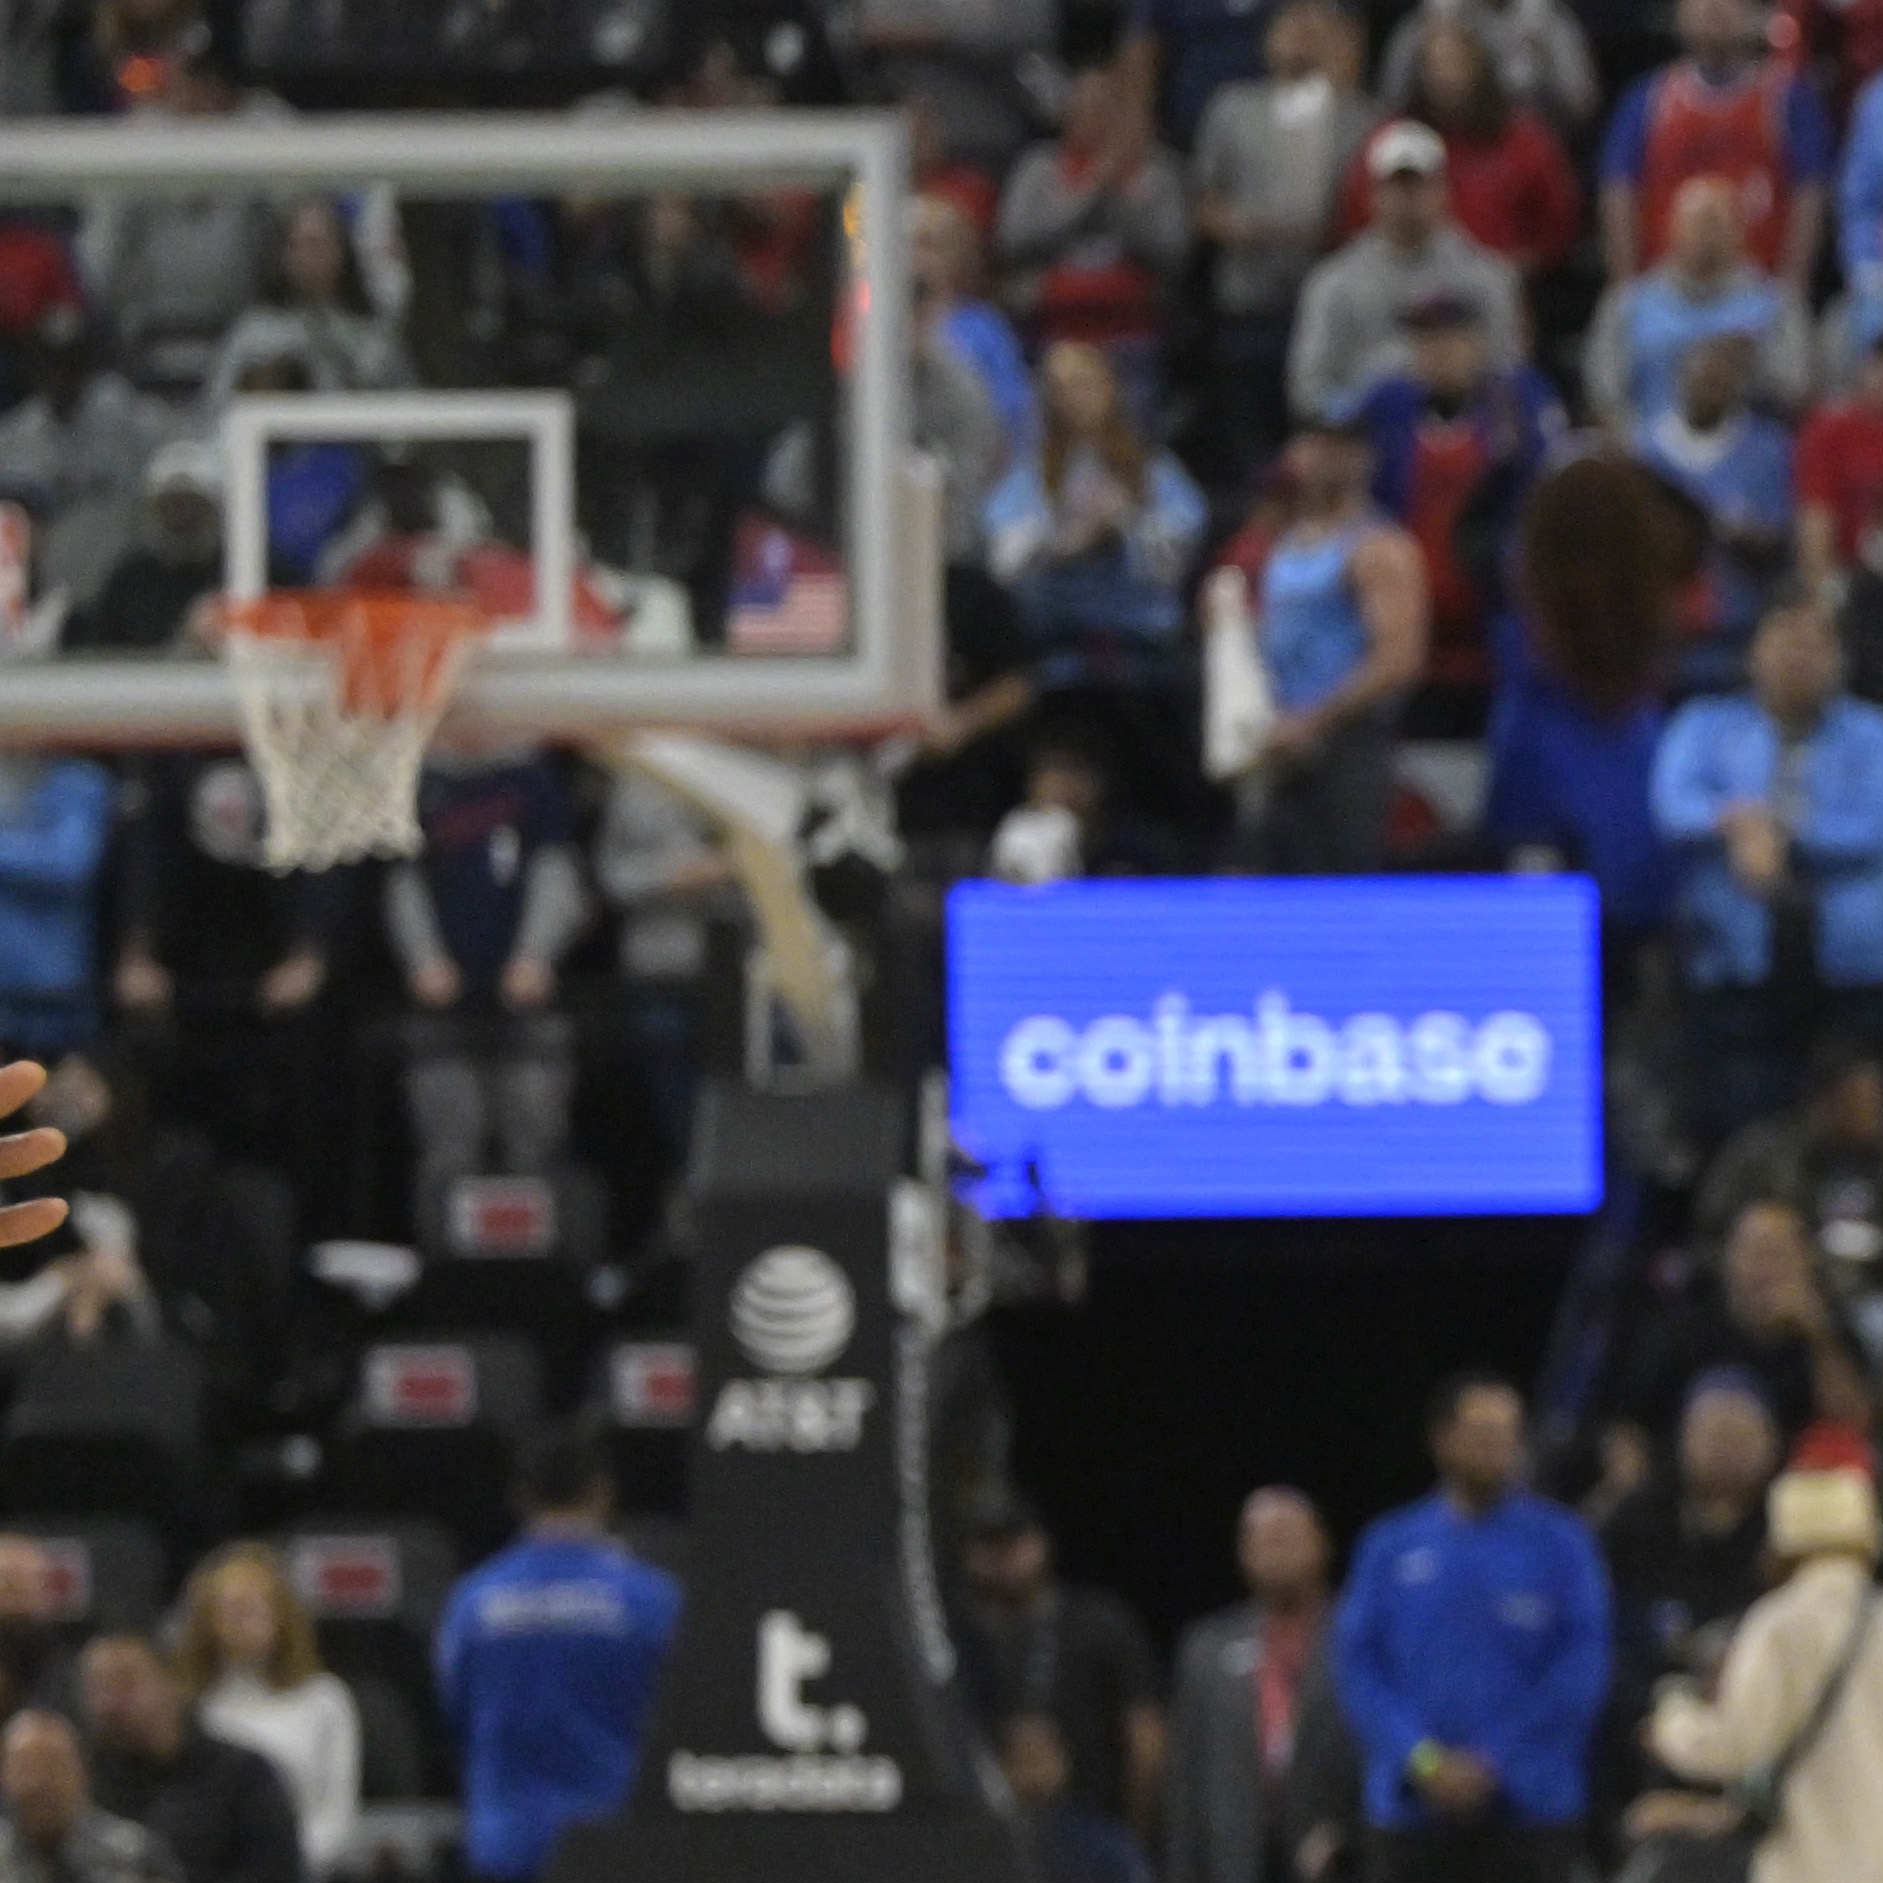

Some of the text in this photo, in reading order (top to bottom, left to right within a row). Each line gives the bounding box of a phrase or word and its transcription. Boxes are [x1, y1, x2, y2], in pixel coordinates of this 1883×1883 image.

[1000, 990, 1553, 1109] coinbase
[707, 1376, 876, 1453] AT&T
[668, 1749, 903, 1813] teradata
